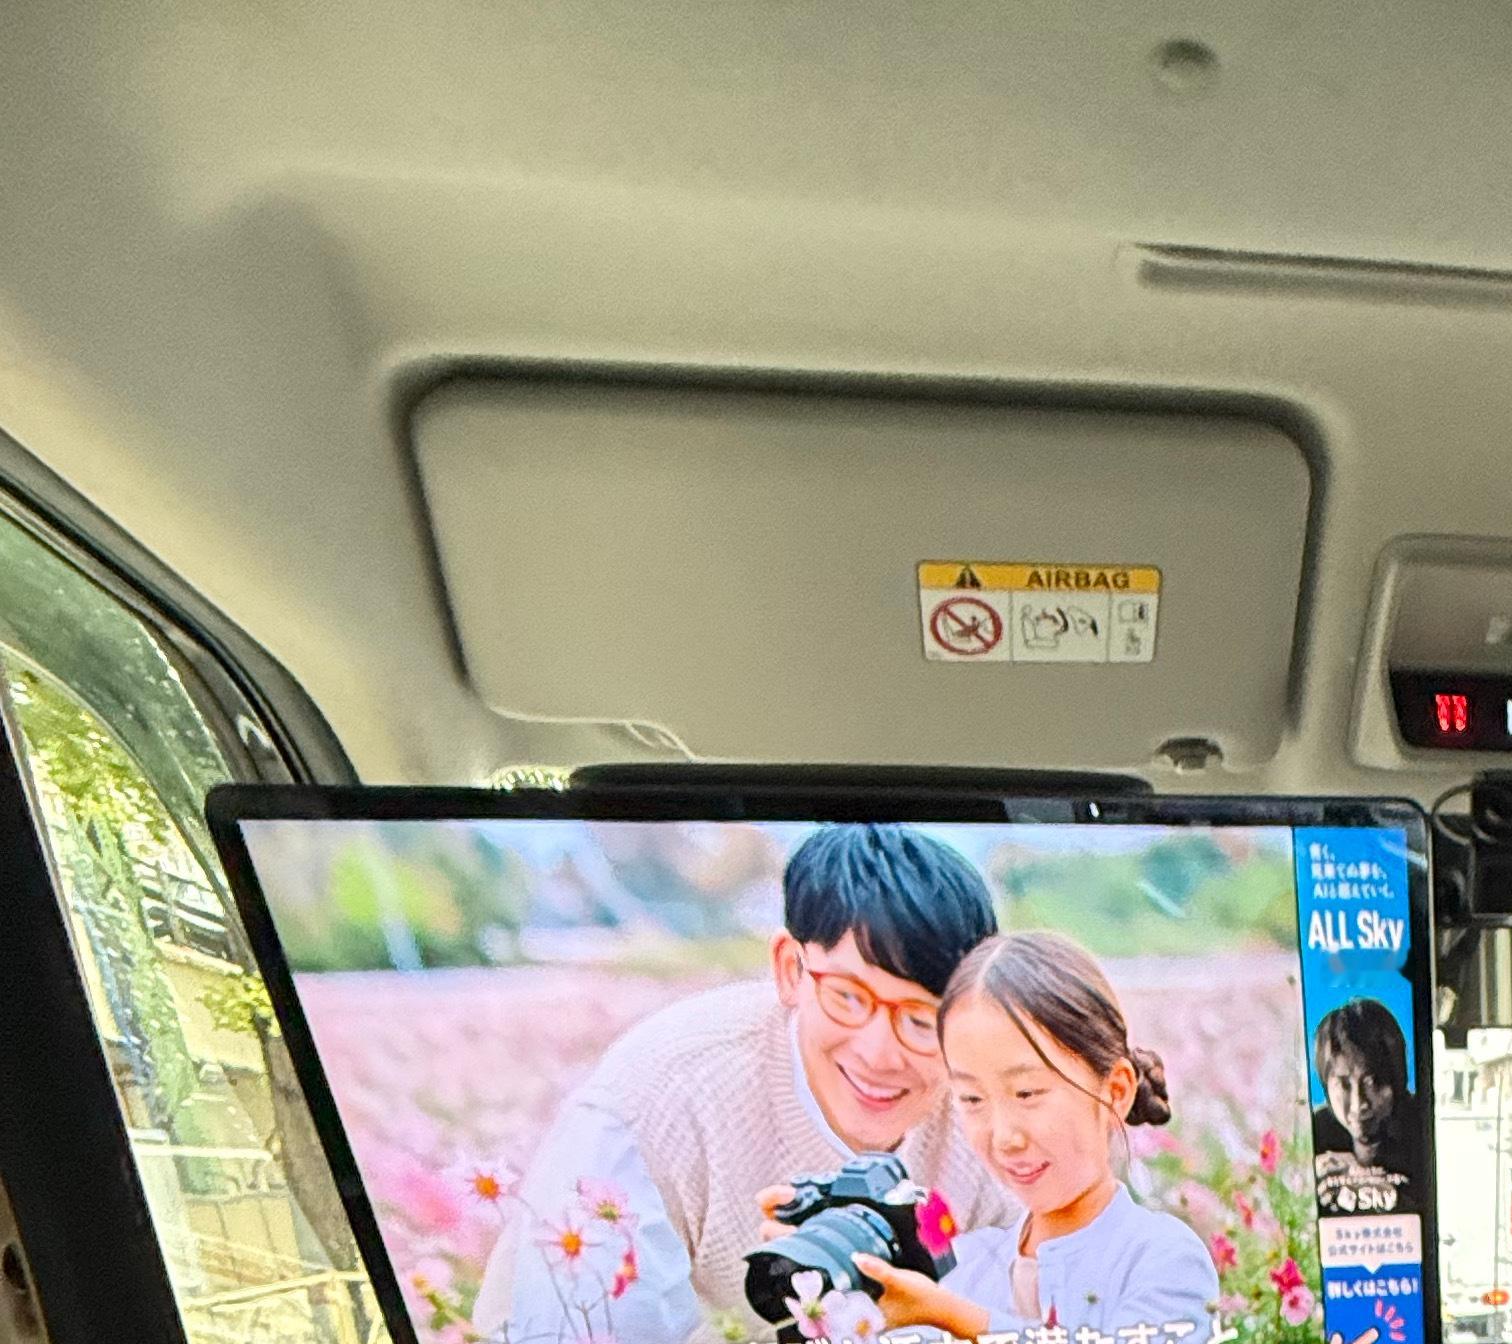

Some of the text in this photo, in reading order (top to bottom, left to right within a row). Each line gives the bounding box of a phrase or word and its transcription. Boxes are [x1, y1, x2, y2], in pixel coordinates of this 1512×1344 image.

[1026, 569, 1131, 590] AIRBAG
[1308, 909, 1405, 953] ALL Sky
